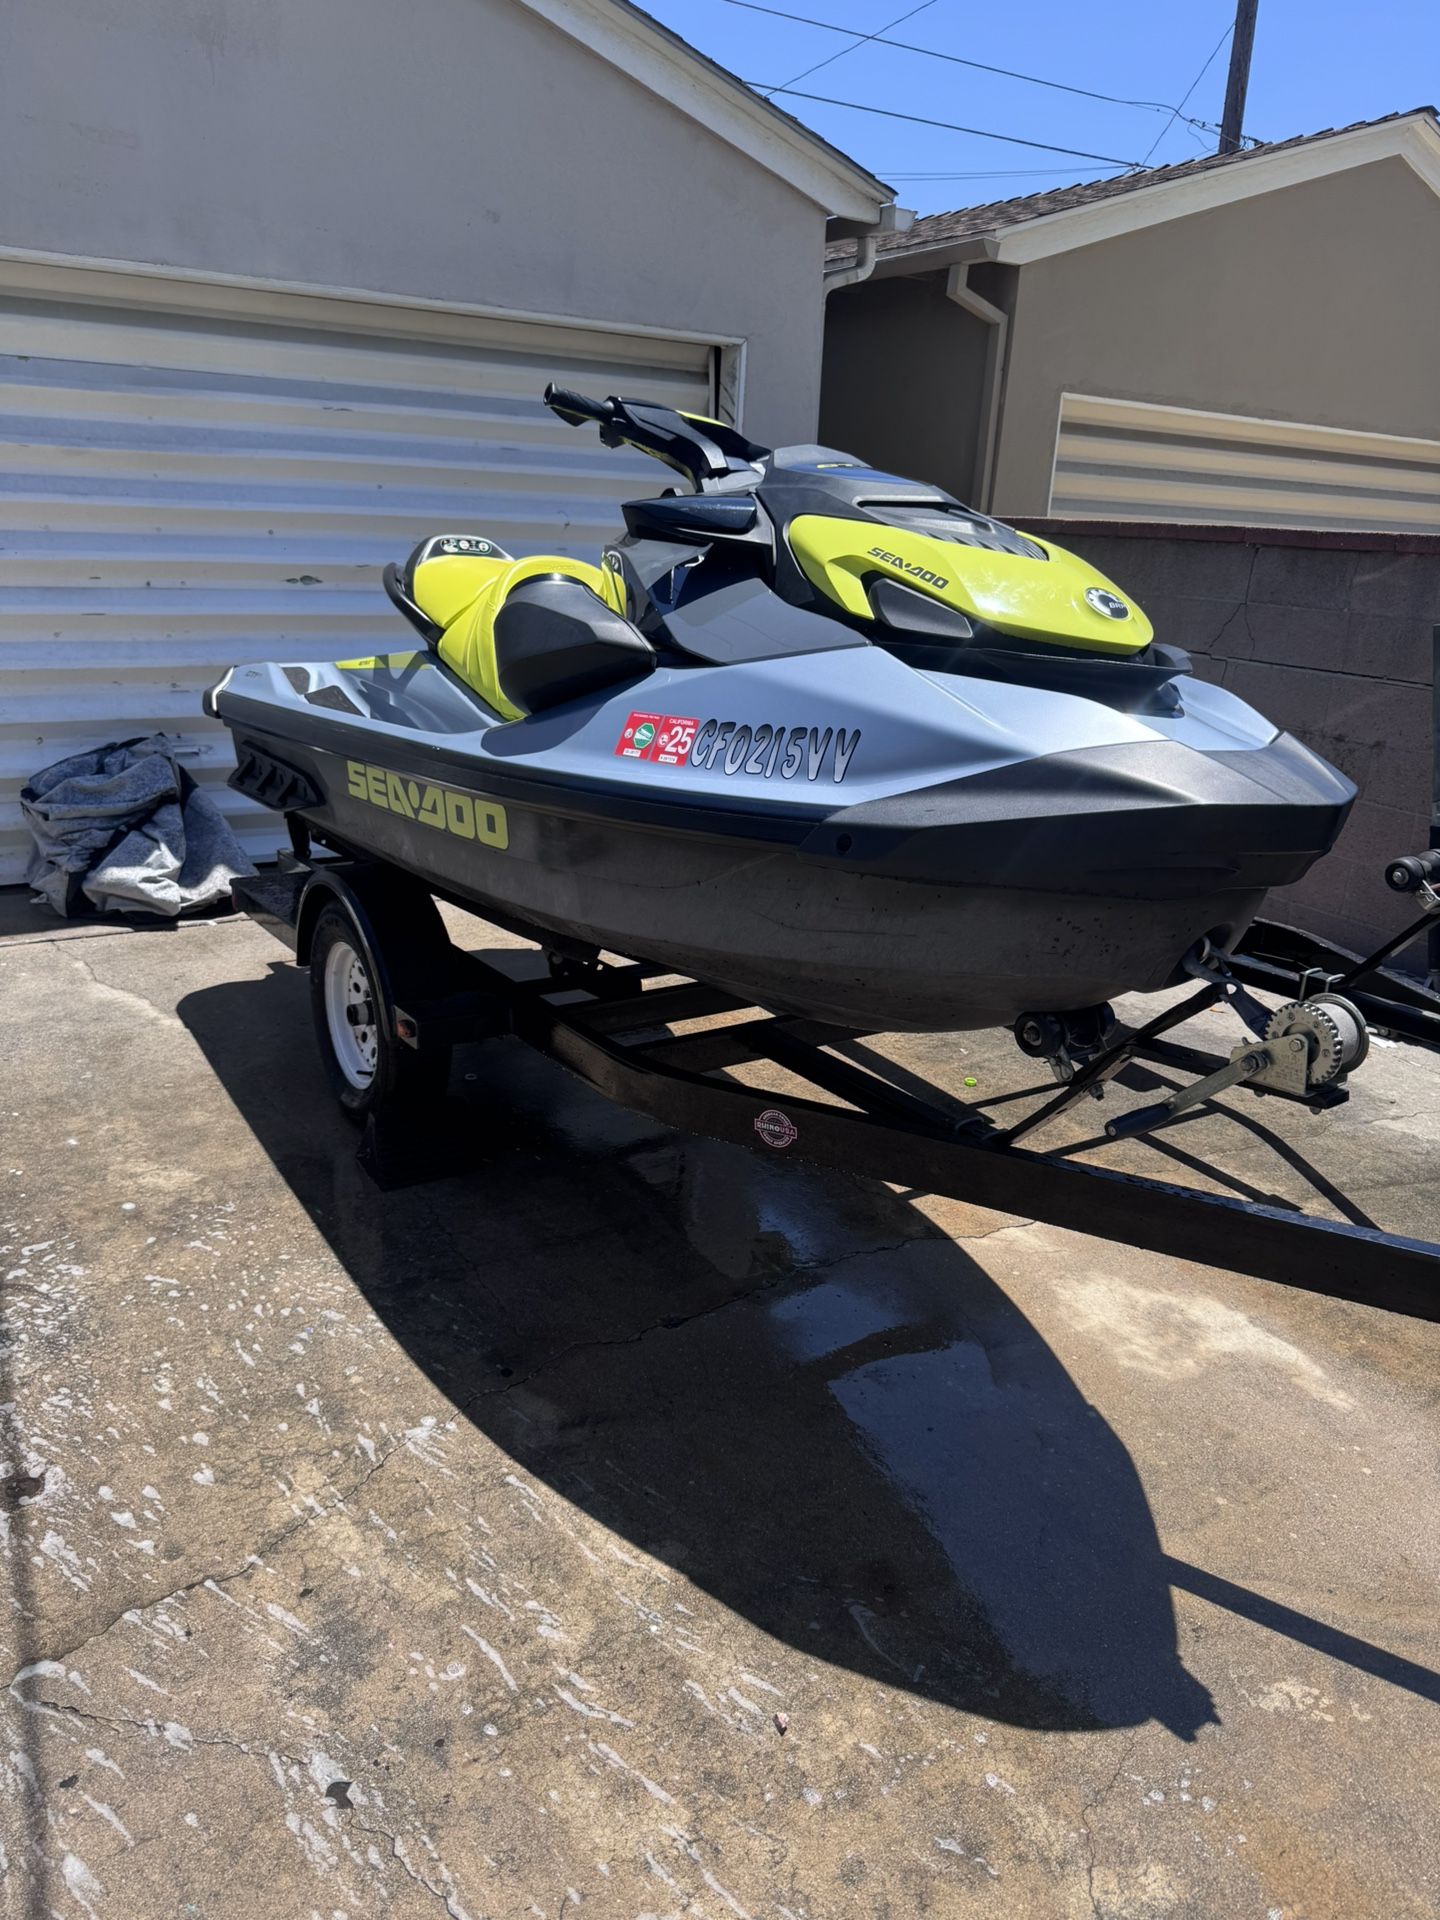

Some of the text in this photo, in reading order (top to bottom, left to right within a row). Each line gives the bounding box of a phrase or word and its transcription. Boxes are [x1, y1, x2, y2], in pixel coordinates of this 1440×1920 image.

[669, 718, 694, 726] CALIFORNIA
[664, 725, 696, 755] 25
[690, 718, 861, 784] CF0215VV
